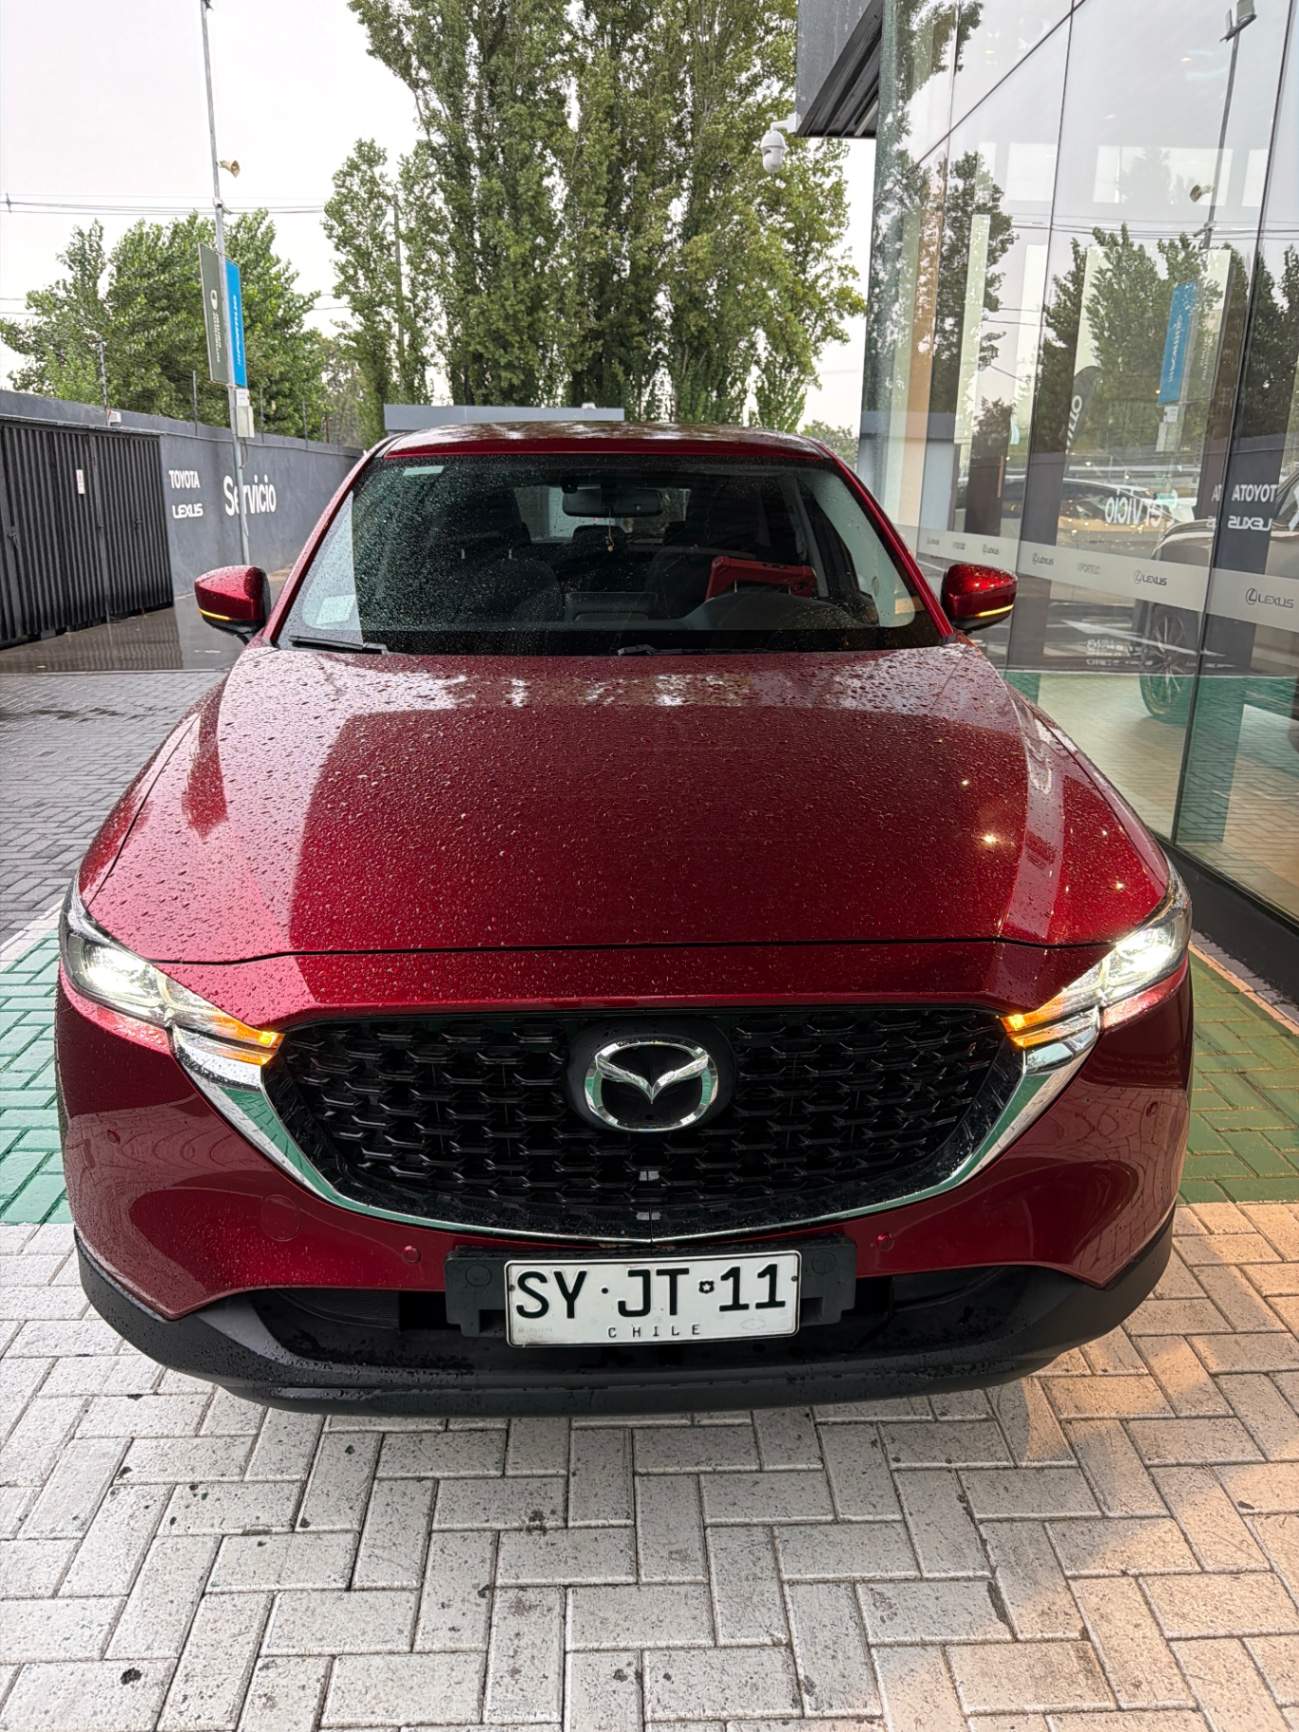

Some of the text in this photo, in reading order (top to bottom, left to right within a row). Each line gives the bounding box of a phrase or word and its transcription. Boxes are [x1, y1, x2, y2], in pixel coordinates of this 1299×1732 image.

[168, 470, 200, 489] TOYOTA
[171, 503, 204, 519] LEXUS
[1257, 592, 1295, 609] LEXUS
[607, 1324, 702, 1339] CHILE
